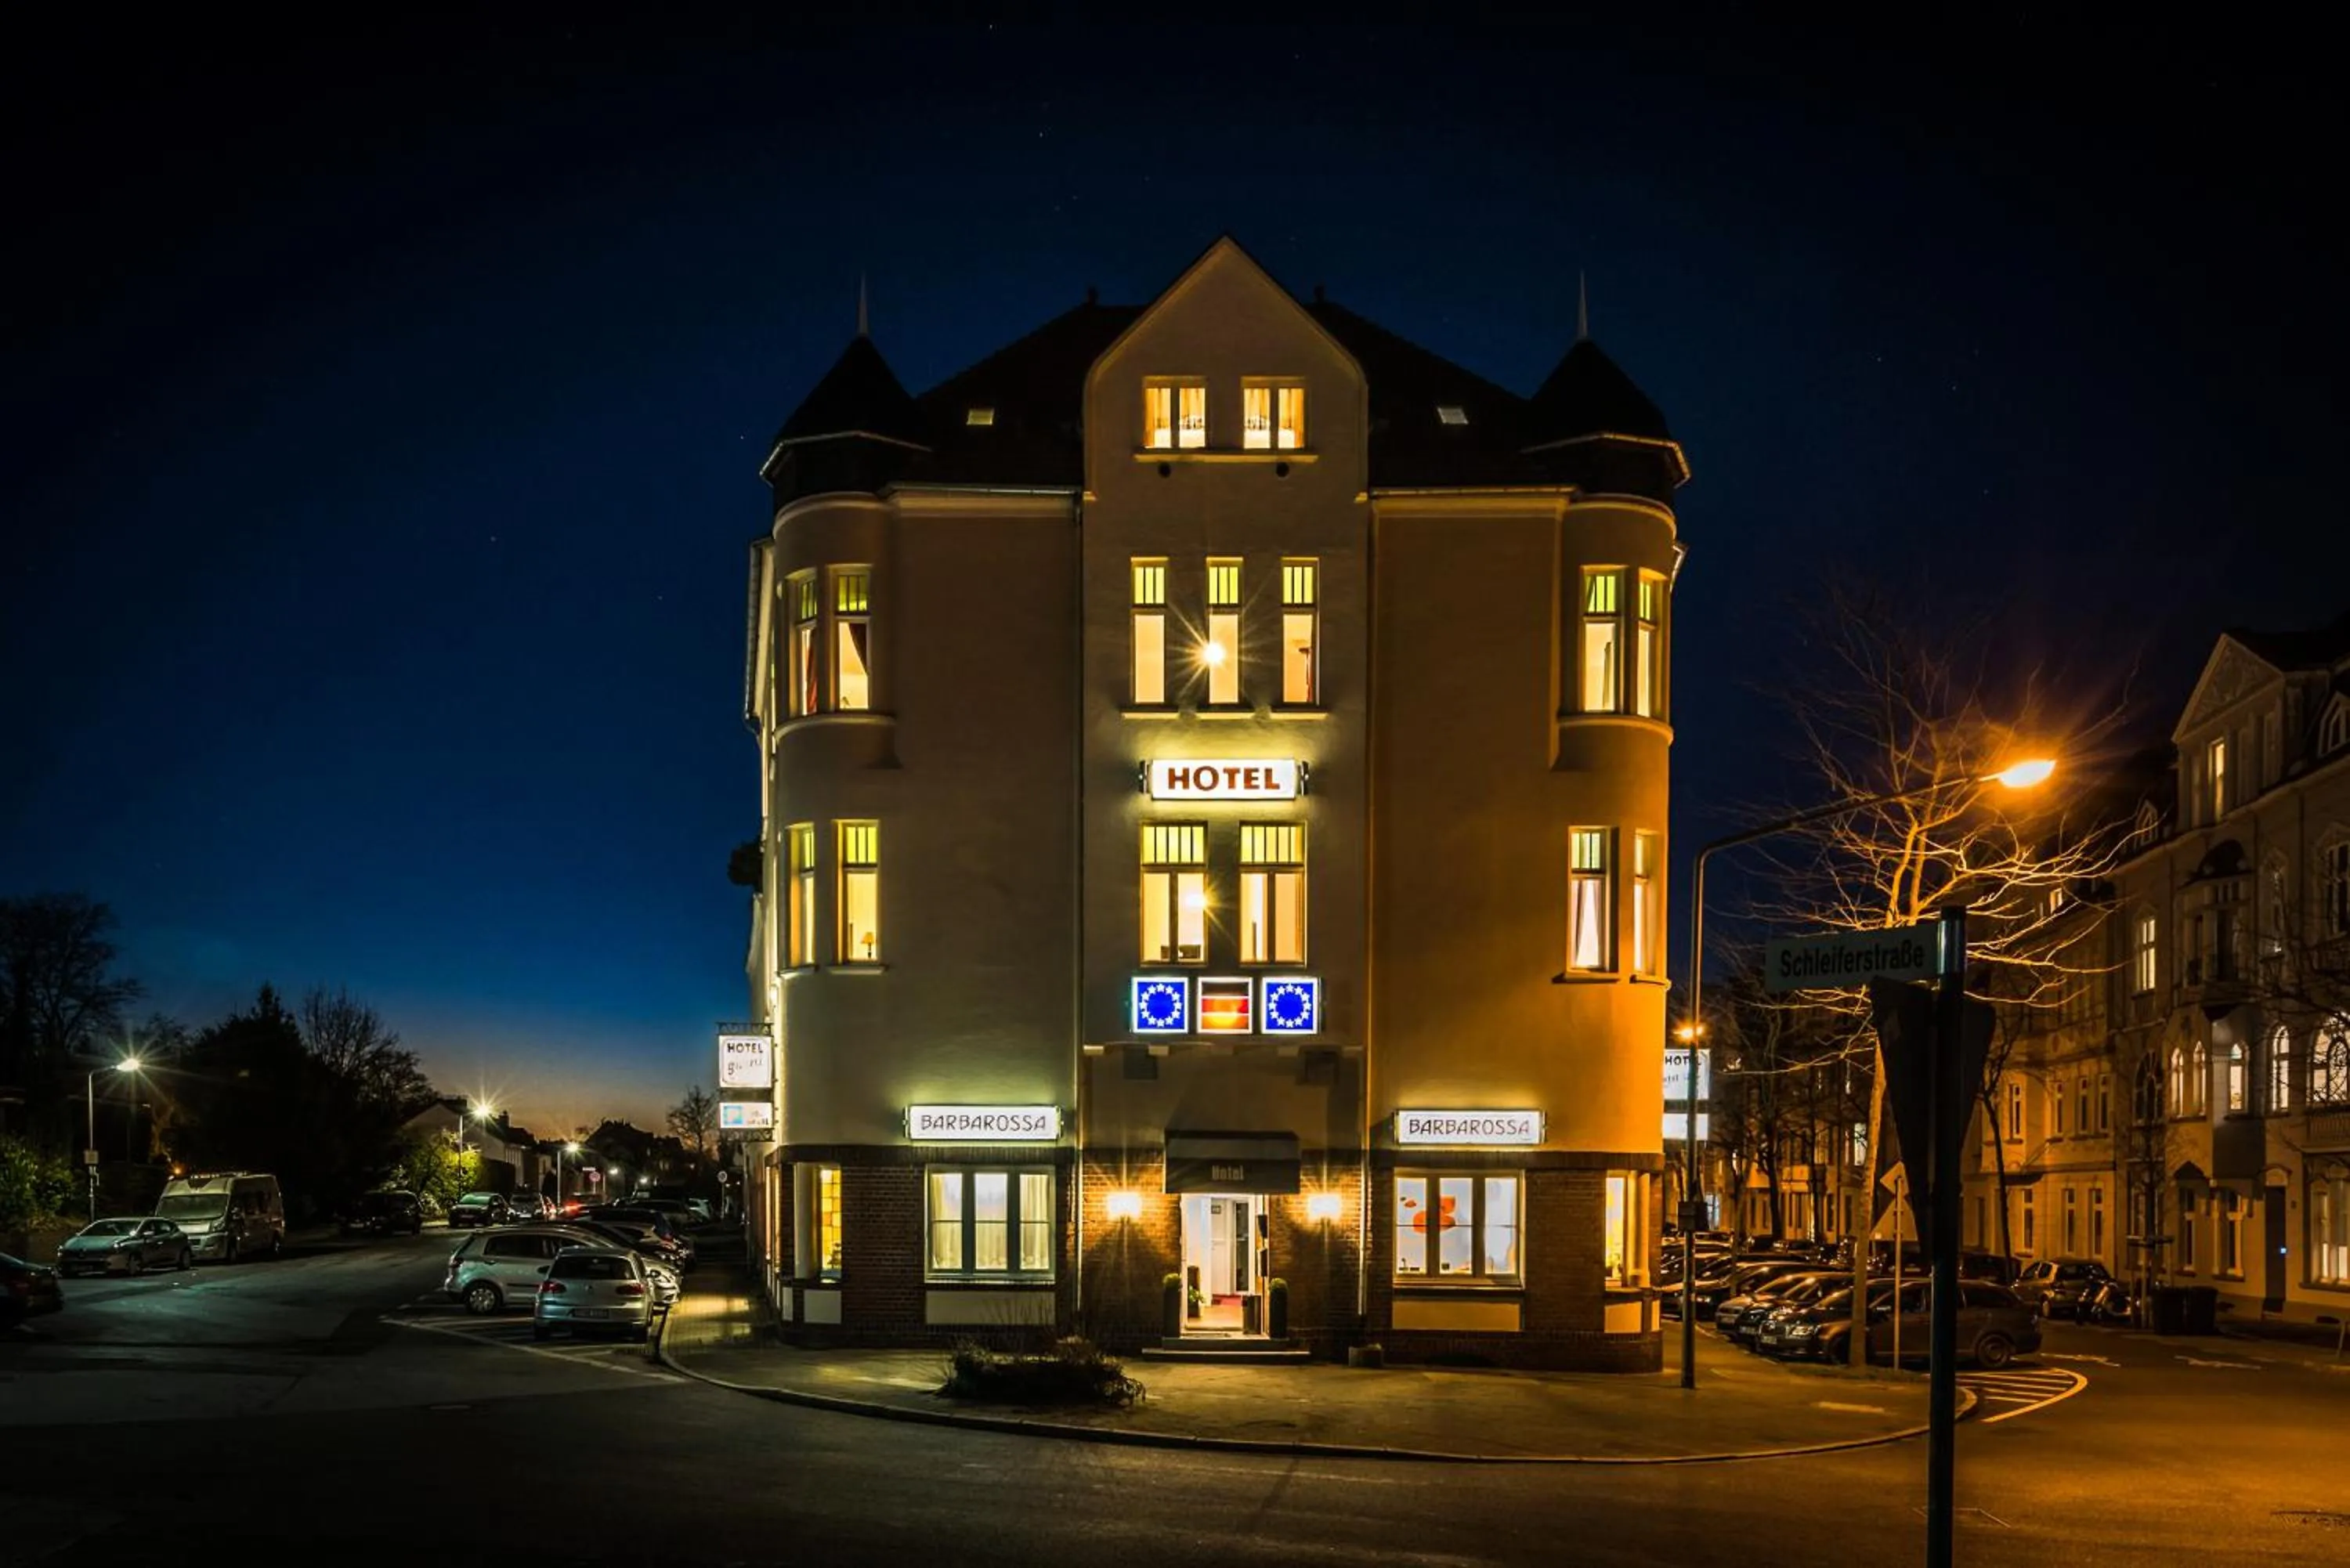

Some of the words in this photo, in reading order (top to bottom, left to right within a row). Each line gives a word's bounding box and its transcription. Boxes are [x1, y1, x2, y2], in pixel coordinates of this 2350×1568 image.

[1168, 765, 1280, 791] HOTEL
[1781, 939, 1925, 977] Schleiferstraße
[727, 1042, 764, 1053] HOTEL
[1665, 1055, 1701, 1066] HOT
[920, 1115, 1046, 1132] BARBAROSSA
[1409, 1119, 1530, 1136] BARBAROSSA
